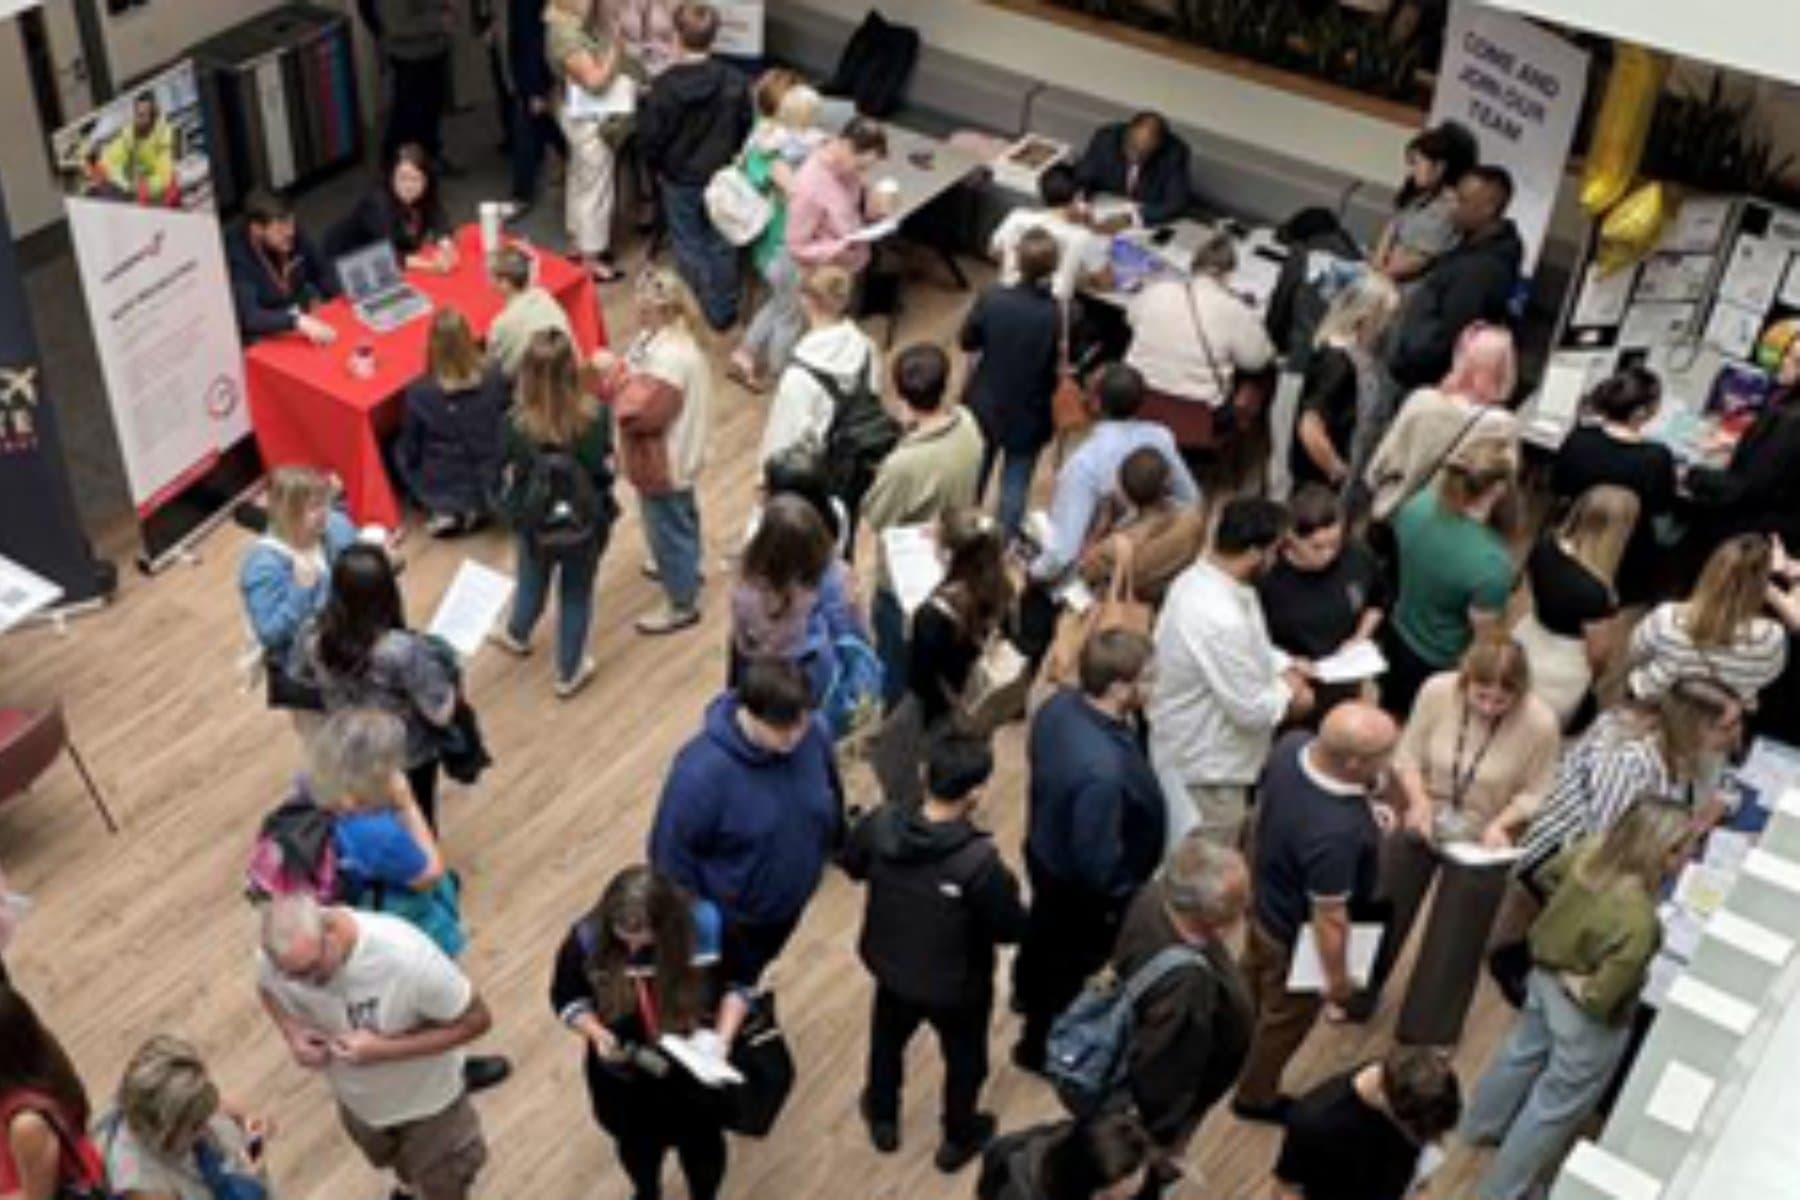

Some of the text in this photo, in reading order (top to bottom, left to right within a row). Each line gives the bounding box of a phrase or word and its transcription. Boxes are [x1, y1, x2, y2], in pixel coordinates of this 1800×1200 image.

[1458, 64, 1545, 125] JOIN OUR
[1463, 32, 1560, 99] COME AND
[1468, 98, 1523, 141] TEAM
